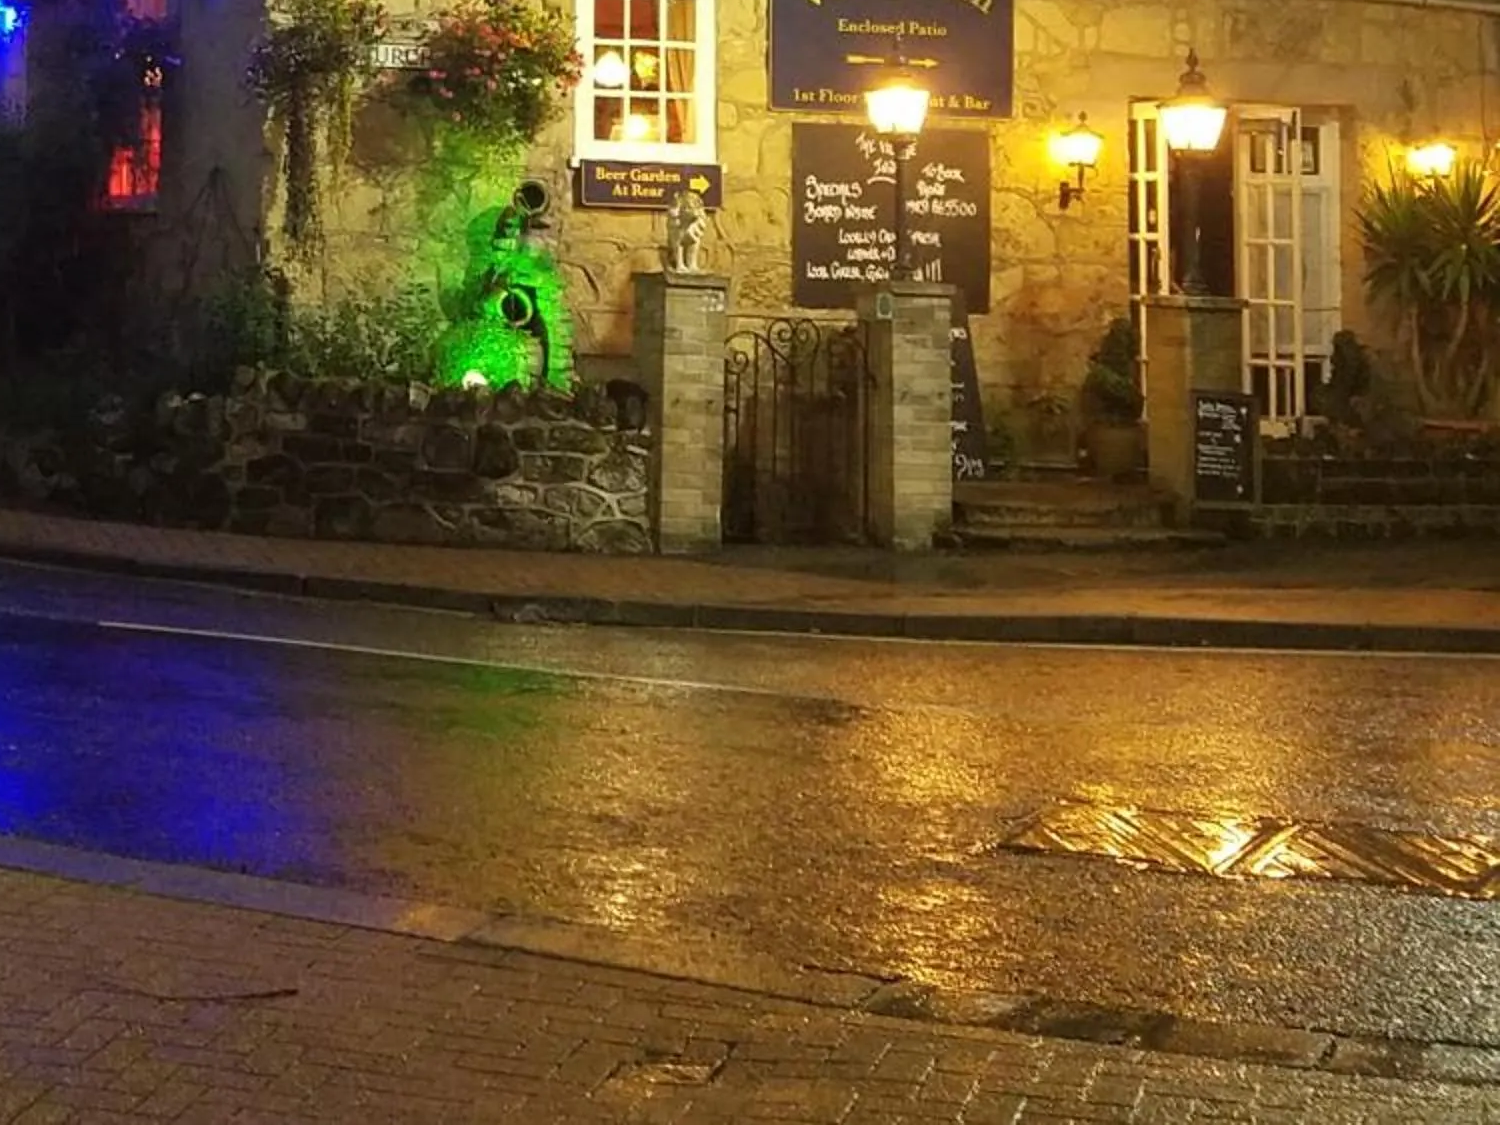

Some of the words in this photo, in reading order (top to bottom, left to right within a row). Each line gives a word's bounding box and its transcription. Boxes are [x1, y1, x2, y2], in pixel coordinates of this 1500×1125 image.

[837, 18, 905, 36] Enclosed
[909, 21, 948, 36] Patio
[793, 88, 815, 104] 1st
[819, 88, 858, 105] Floor
[965, 96, 992, 111] Bar
[595, 166, 627, 181] Beer
[630, 168, 681, 183] Garden
[612, 183, 629, 197] At
[631, 184, 664, 198] Rear
